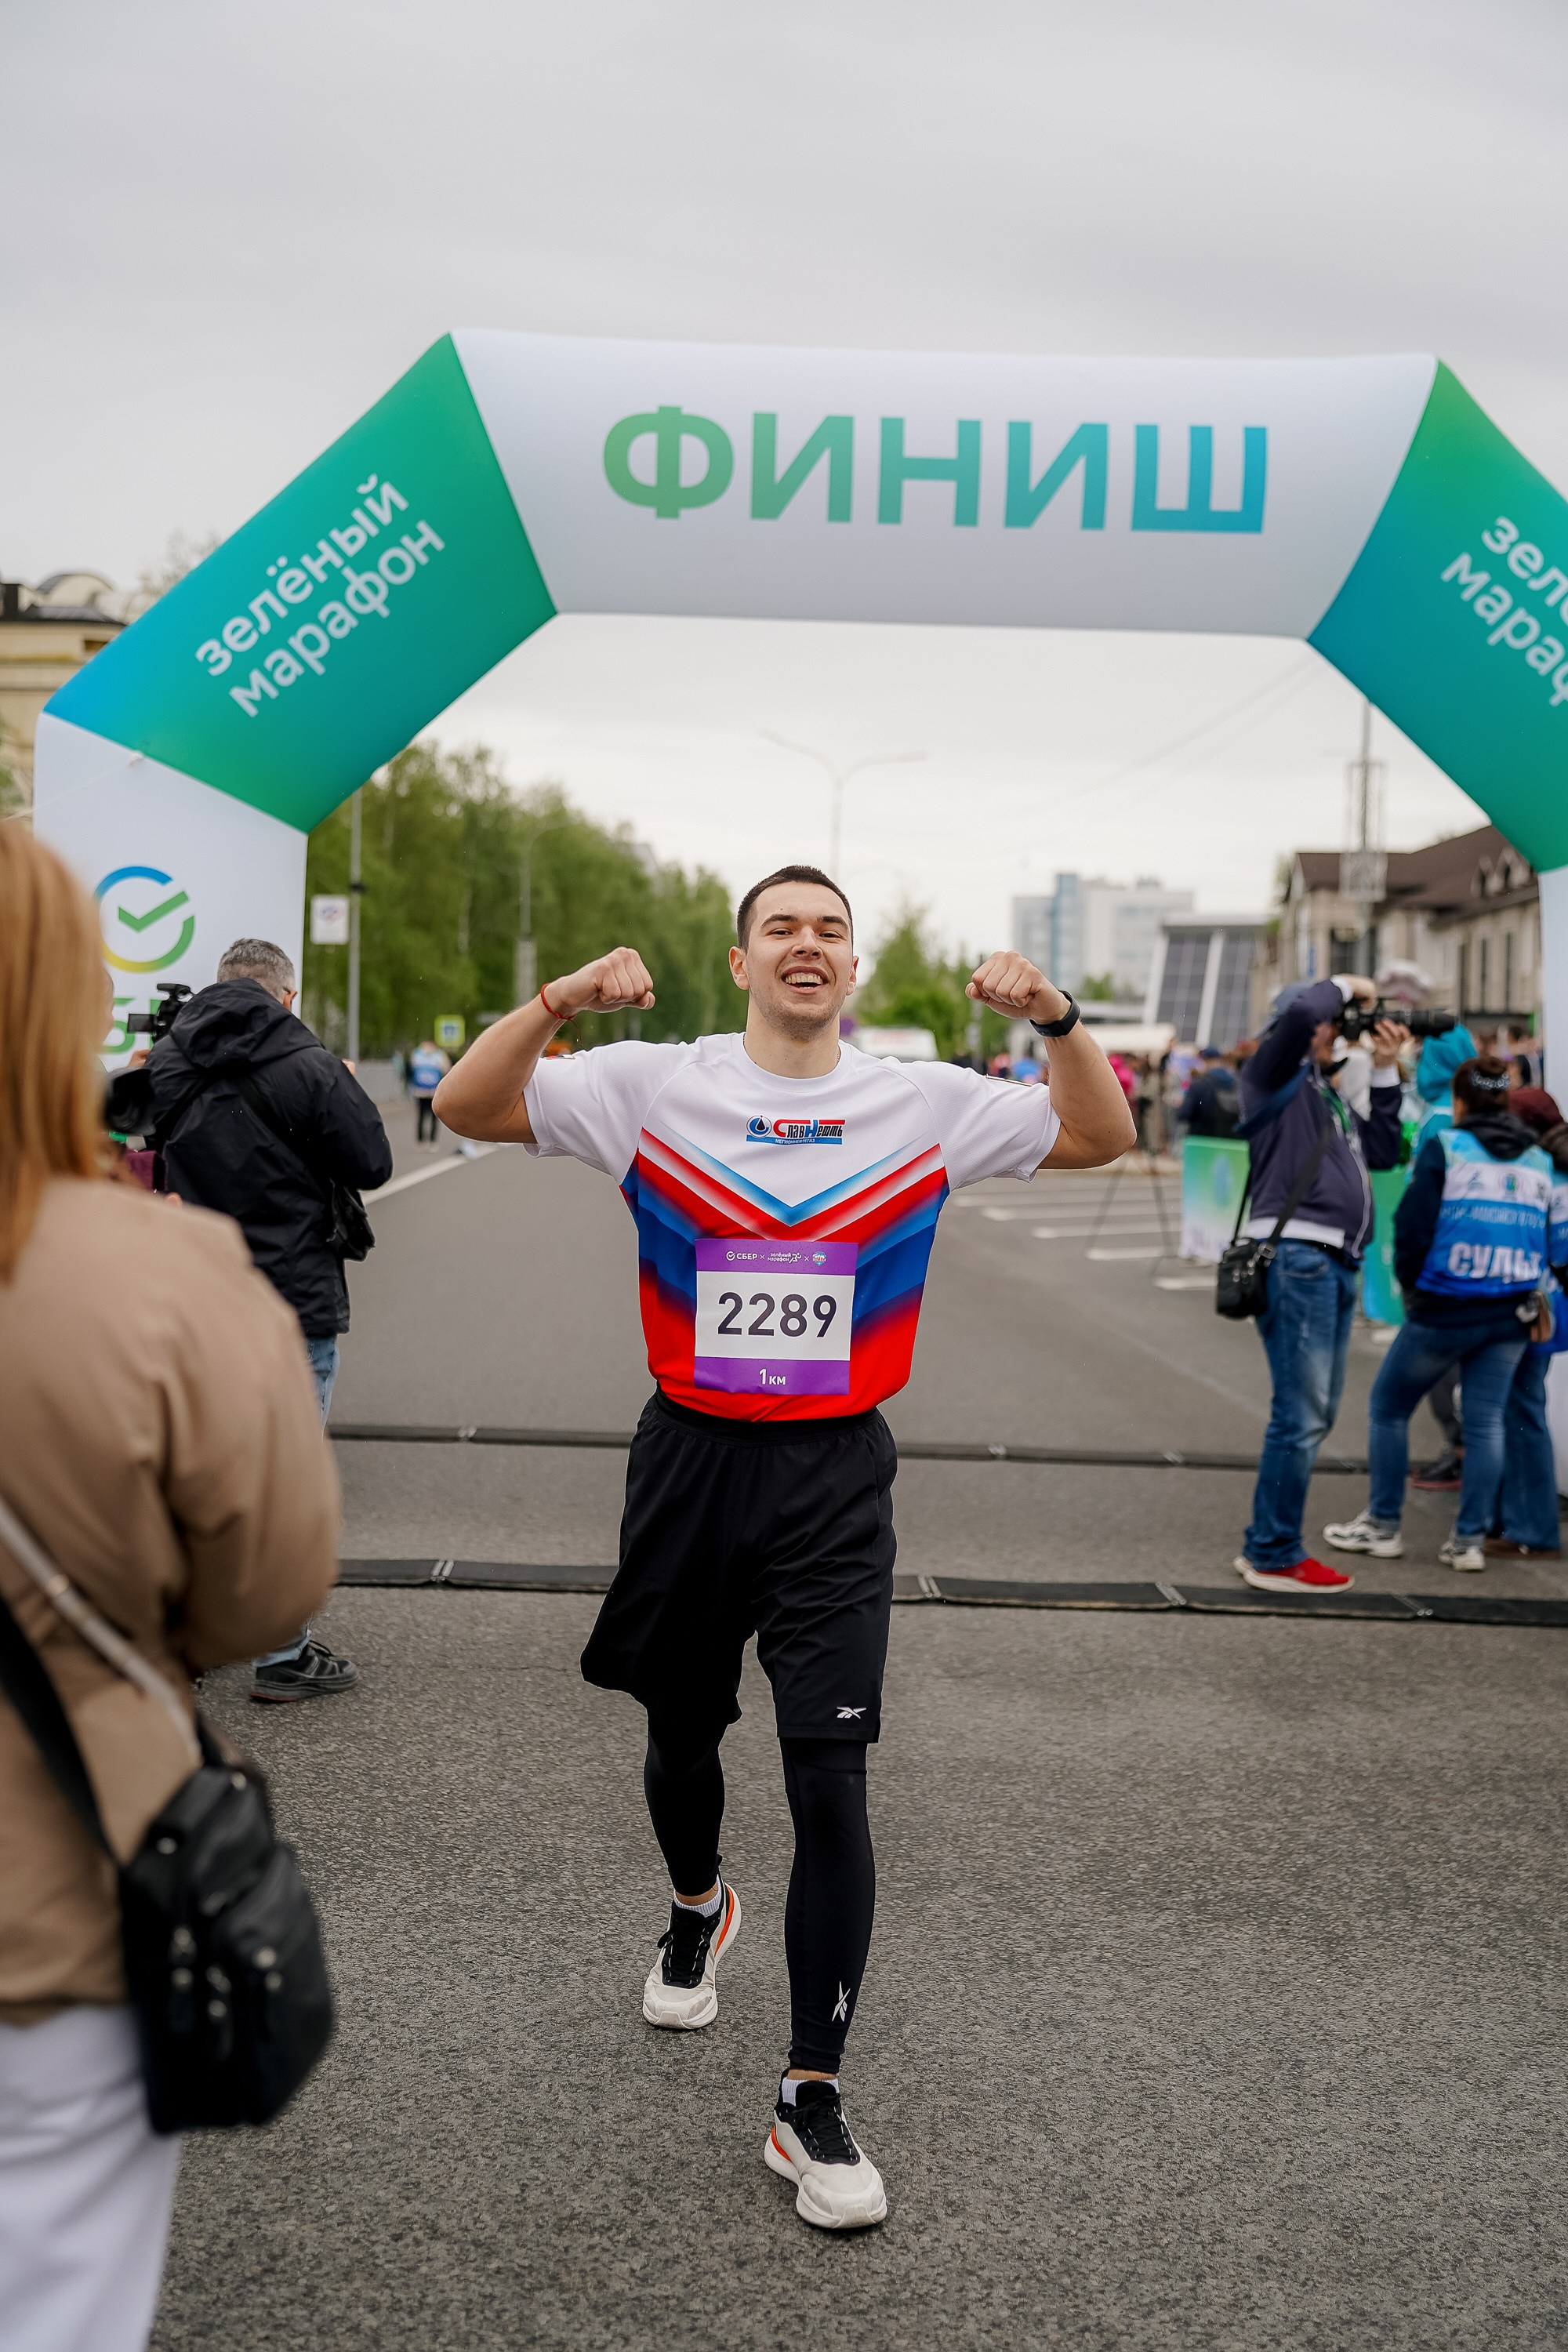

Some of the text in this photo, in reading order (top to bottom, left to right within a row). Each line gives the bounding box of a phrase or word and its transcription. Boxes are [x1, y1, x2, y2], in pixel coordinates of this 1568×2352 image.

[603, 405, 1268, 535] ФИНИШ
[194, 473, 409, 677] зелёный
[229, 520, 445, 718] марафон
[1481, 515, 1568, 628] зел
[717, 1291, 837, 1338] 2289
